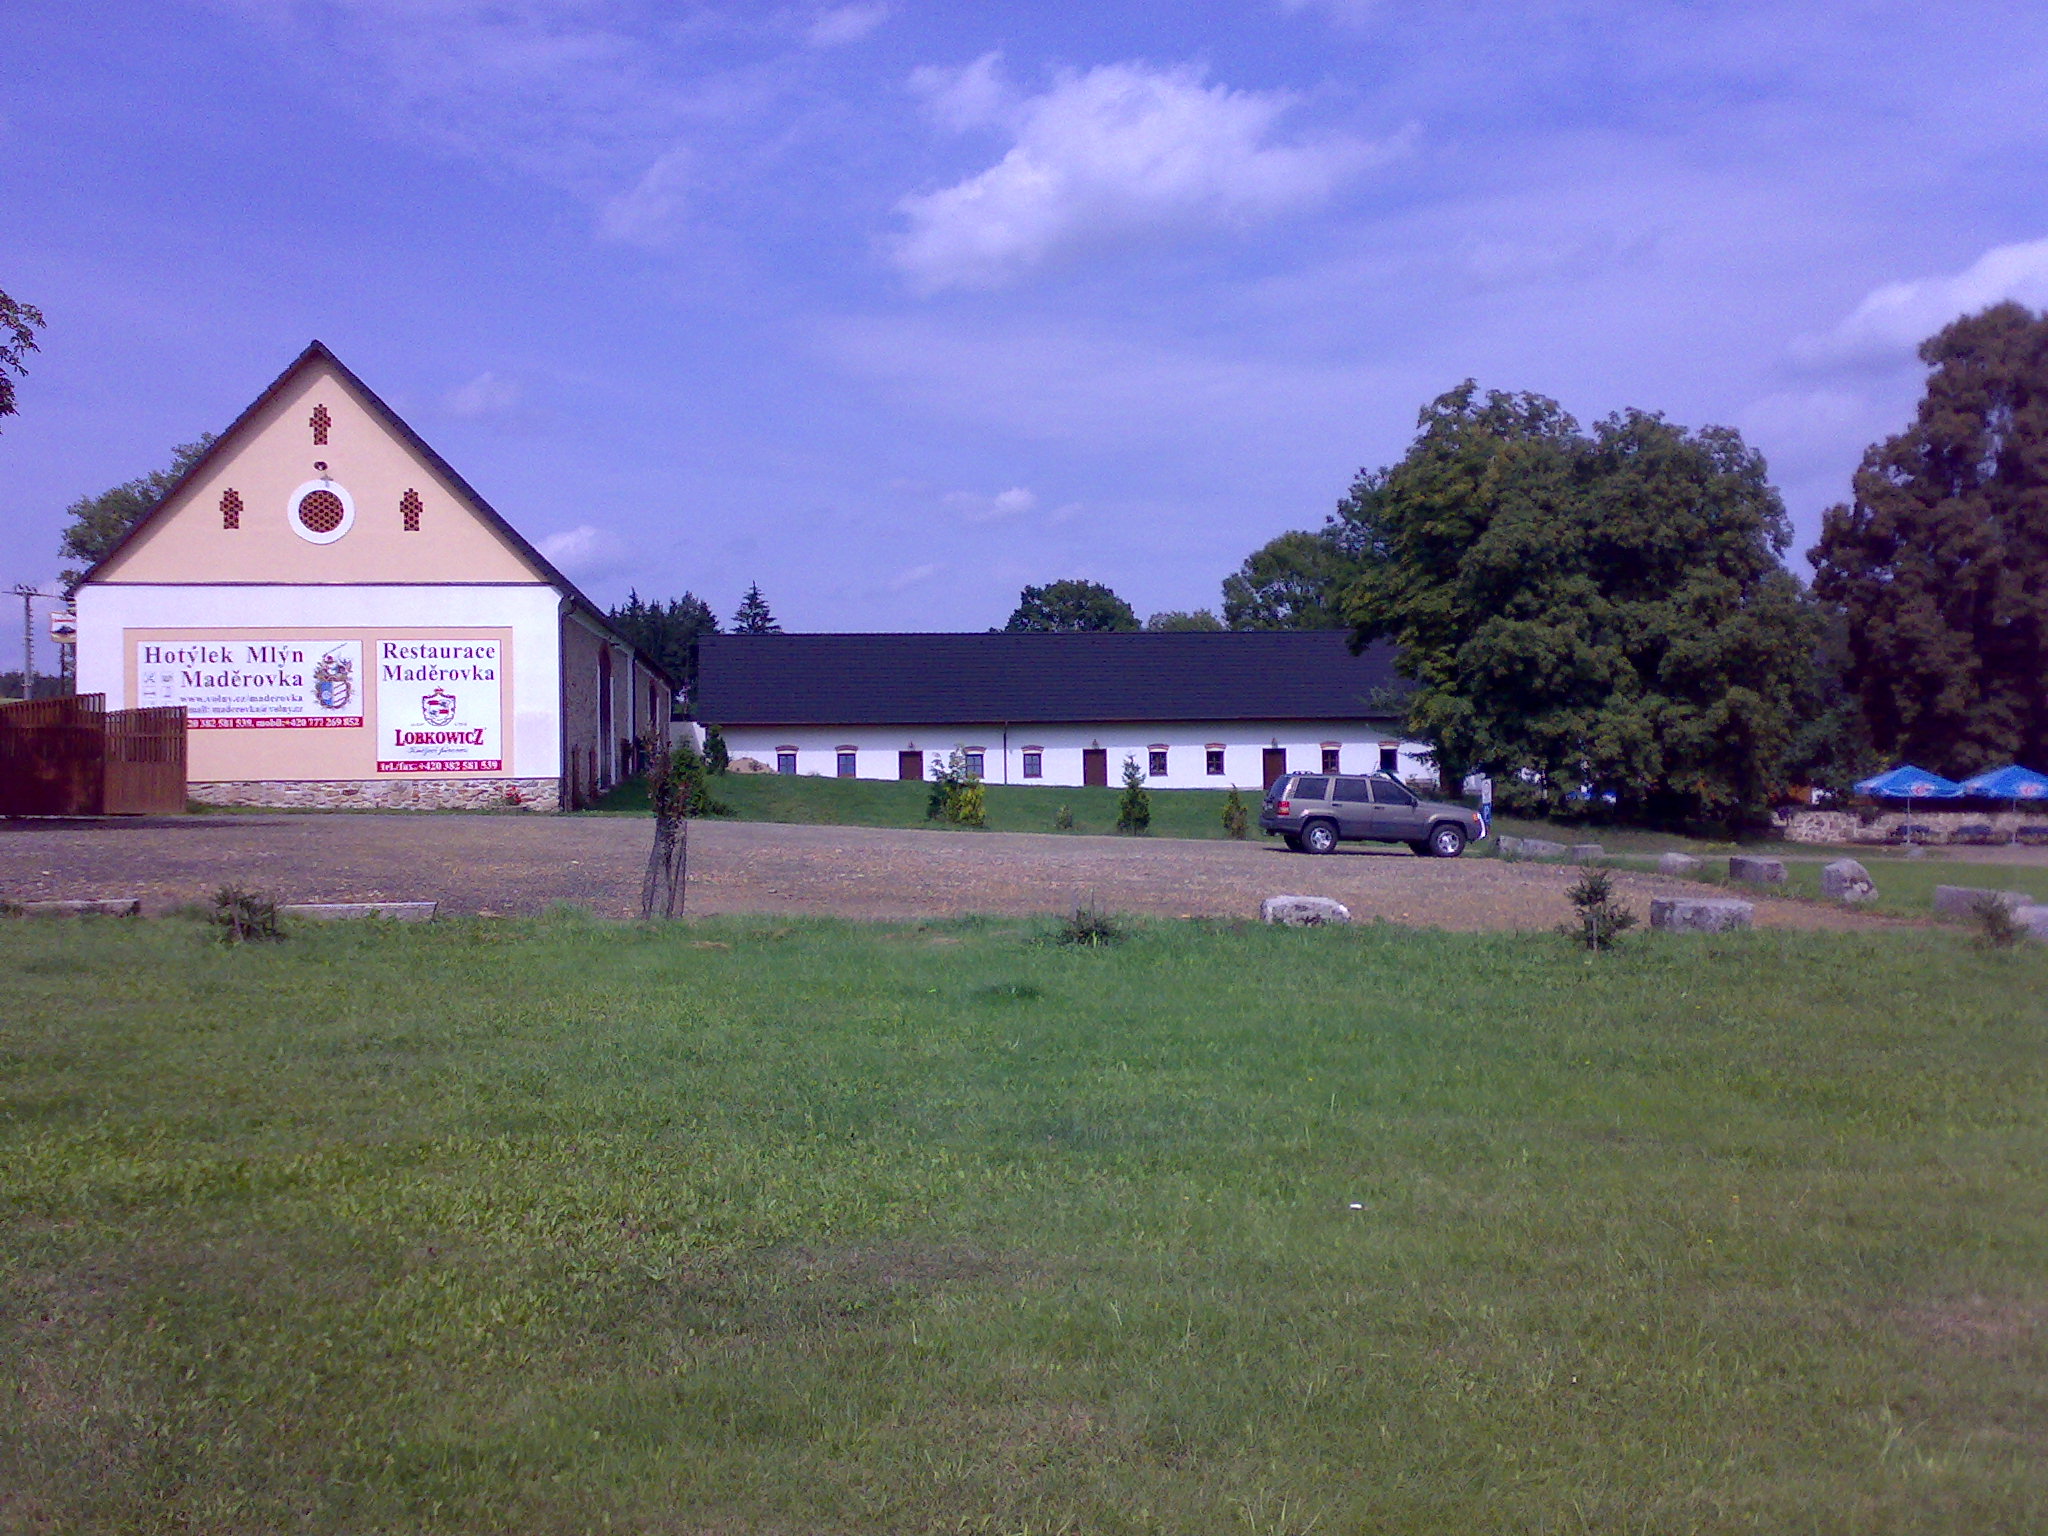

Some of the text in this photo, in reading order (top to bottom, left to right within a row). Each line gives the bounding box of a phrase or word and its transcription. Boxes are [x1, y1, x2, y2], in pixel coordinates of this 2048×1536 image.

[145, 644, 304, 668] Hotýlek Mlýn
[383, 642, 496, 660] Restaurace
[181, 670, 304, 688] Maděrovka
[383, 664, 495, 681] Maděrovka
[394, 728, 485, 747] LOBKOWICZ
